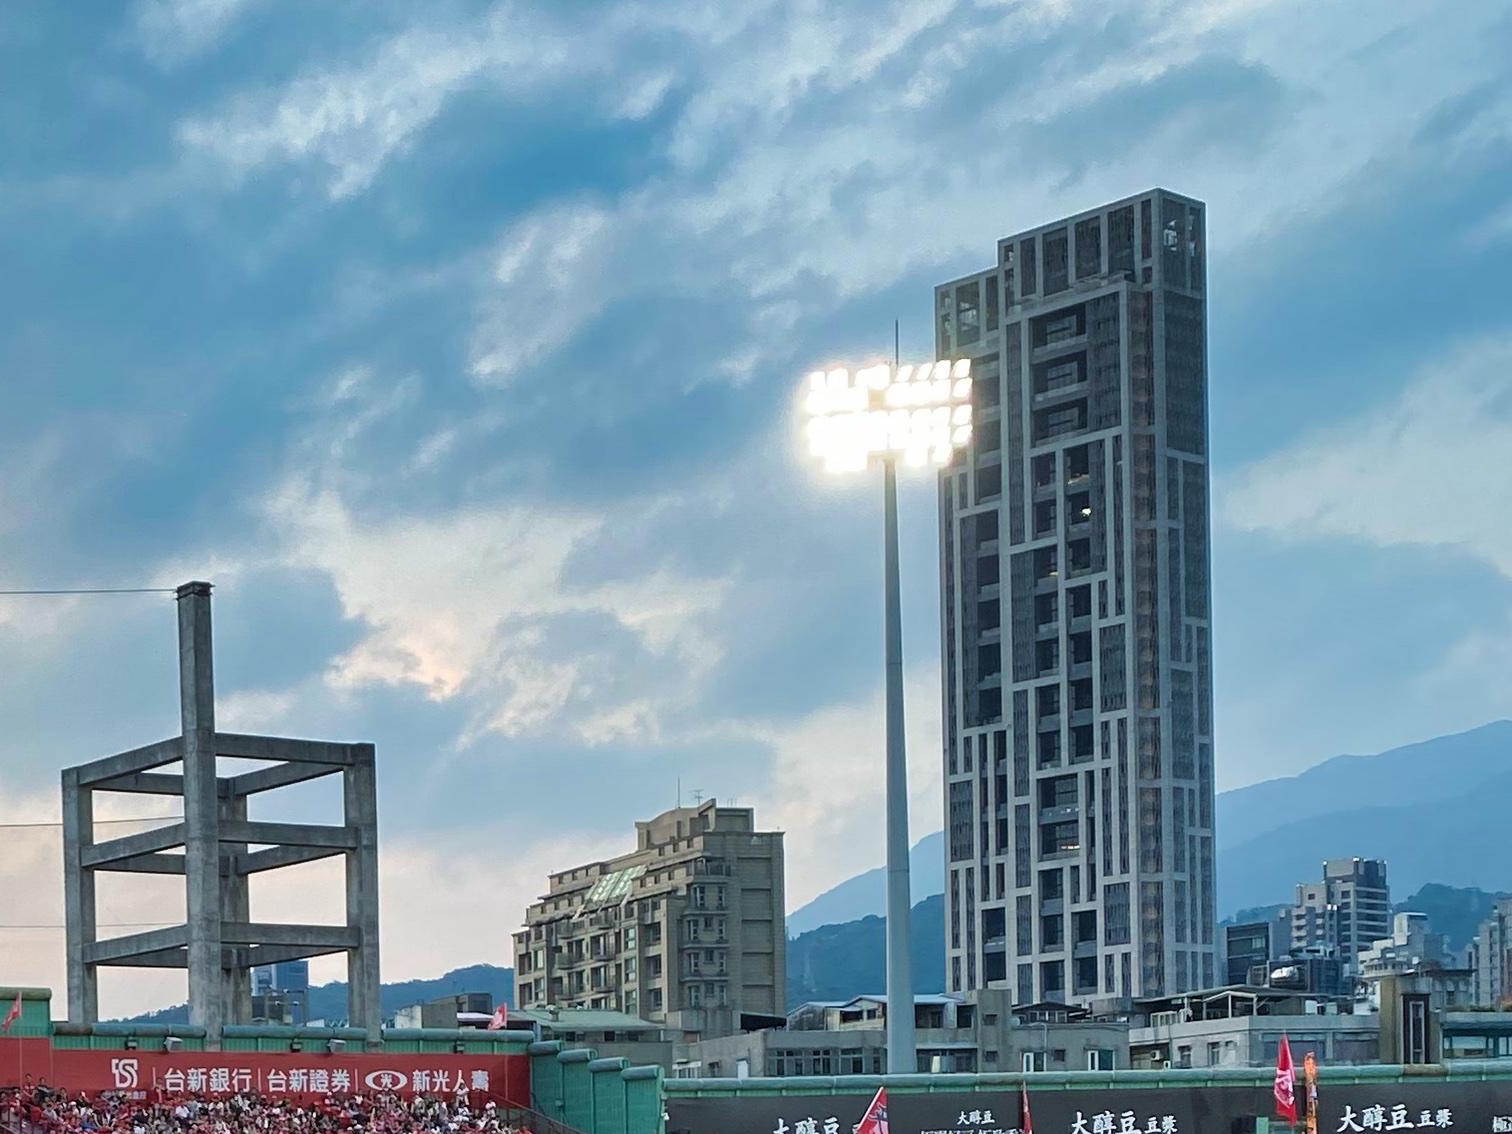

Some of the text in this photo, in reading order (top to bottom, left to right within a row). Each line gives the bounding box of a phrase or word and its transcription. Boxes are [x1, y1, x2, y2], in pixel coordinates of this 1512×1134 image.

[164, 1067, 252, 1092] 台新銀行
[267, 1068, 352, 1094] 台新證券
[957, 1110, 995, 1125] 大醇豆
[1337, 1103, 1414, 1134] 大醇豆
